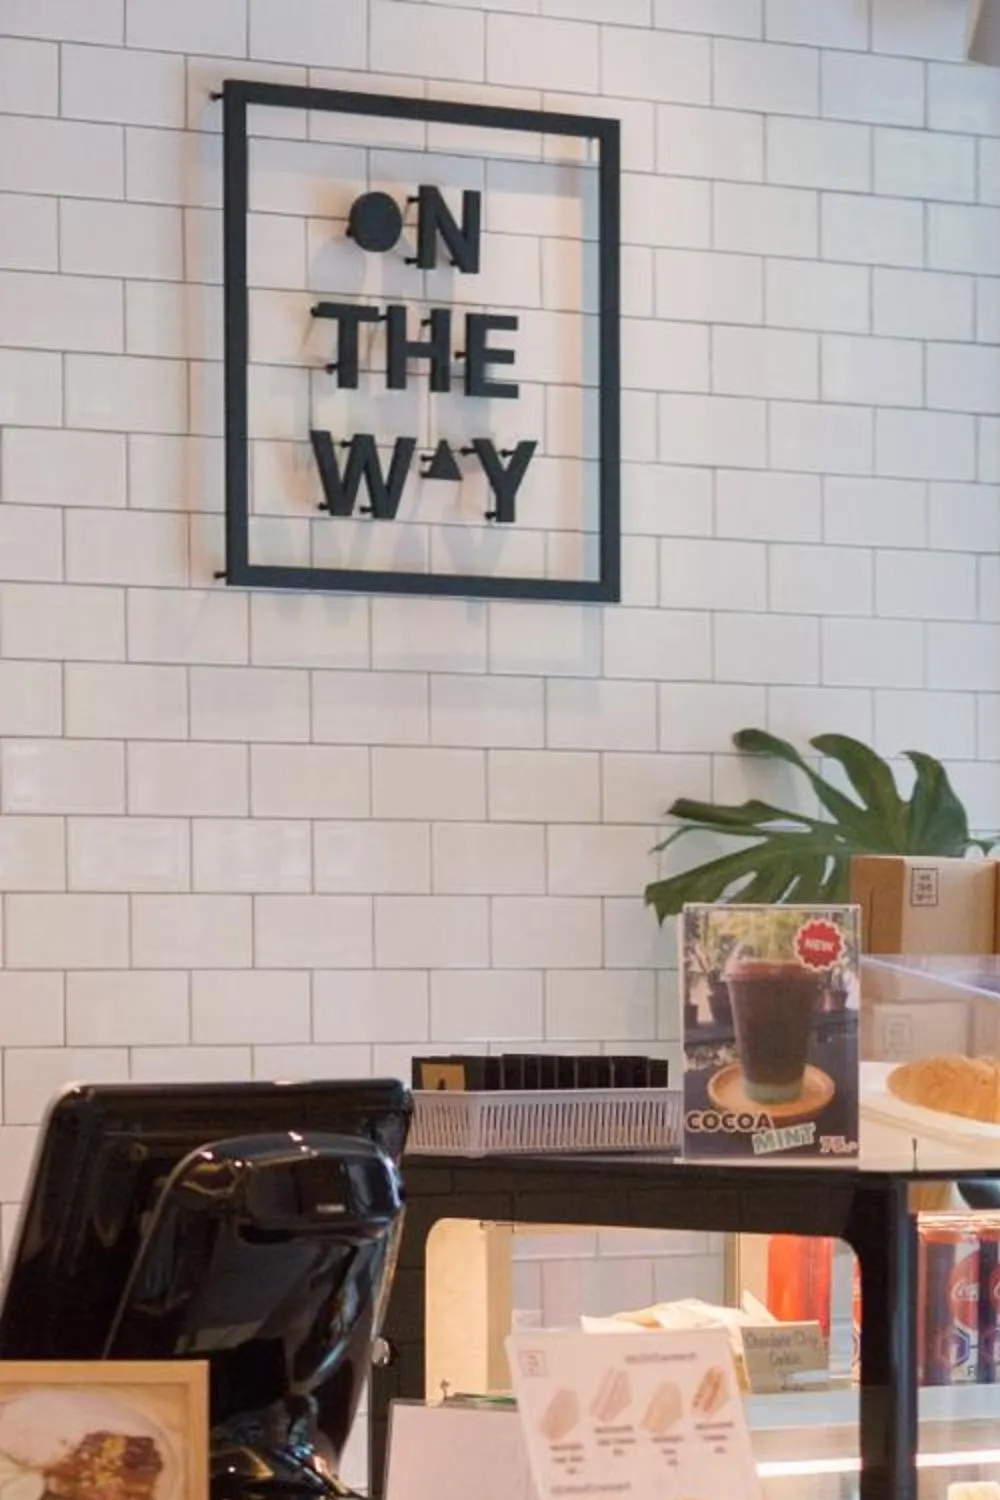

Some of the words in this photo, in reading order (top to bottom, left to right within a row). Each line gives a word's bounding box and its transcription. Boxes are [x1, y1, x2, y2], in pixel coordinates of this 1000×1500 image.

[349, 185, 482, 274] ON
[315, 302, 519, 399] THE
[310, 430, 538, 522] WAY
[805, 938, 834, 951] NEW
[685, 1110, 774, 1132] COCOA
[752, 1122, 816, 1155] MINT
